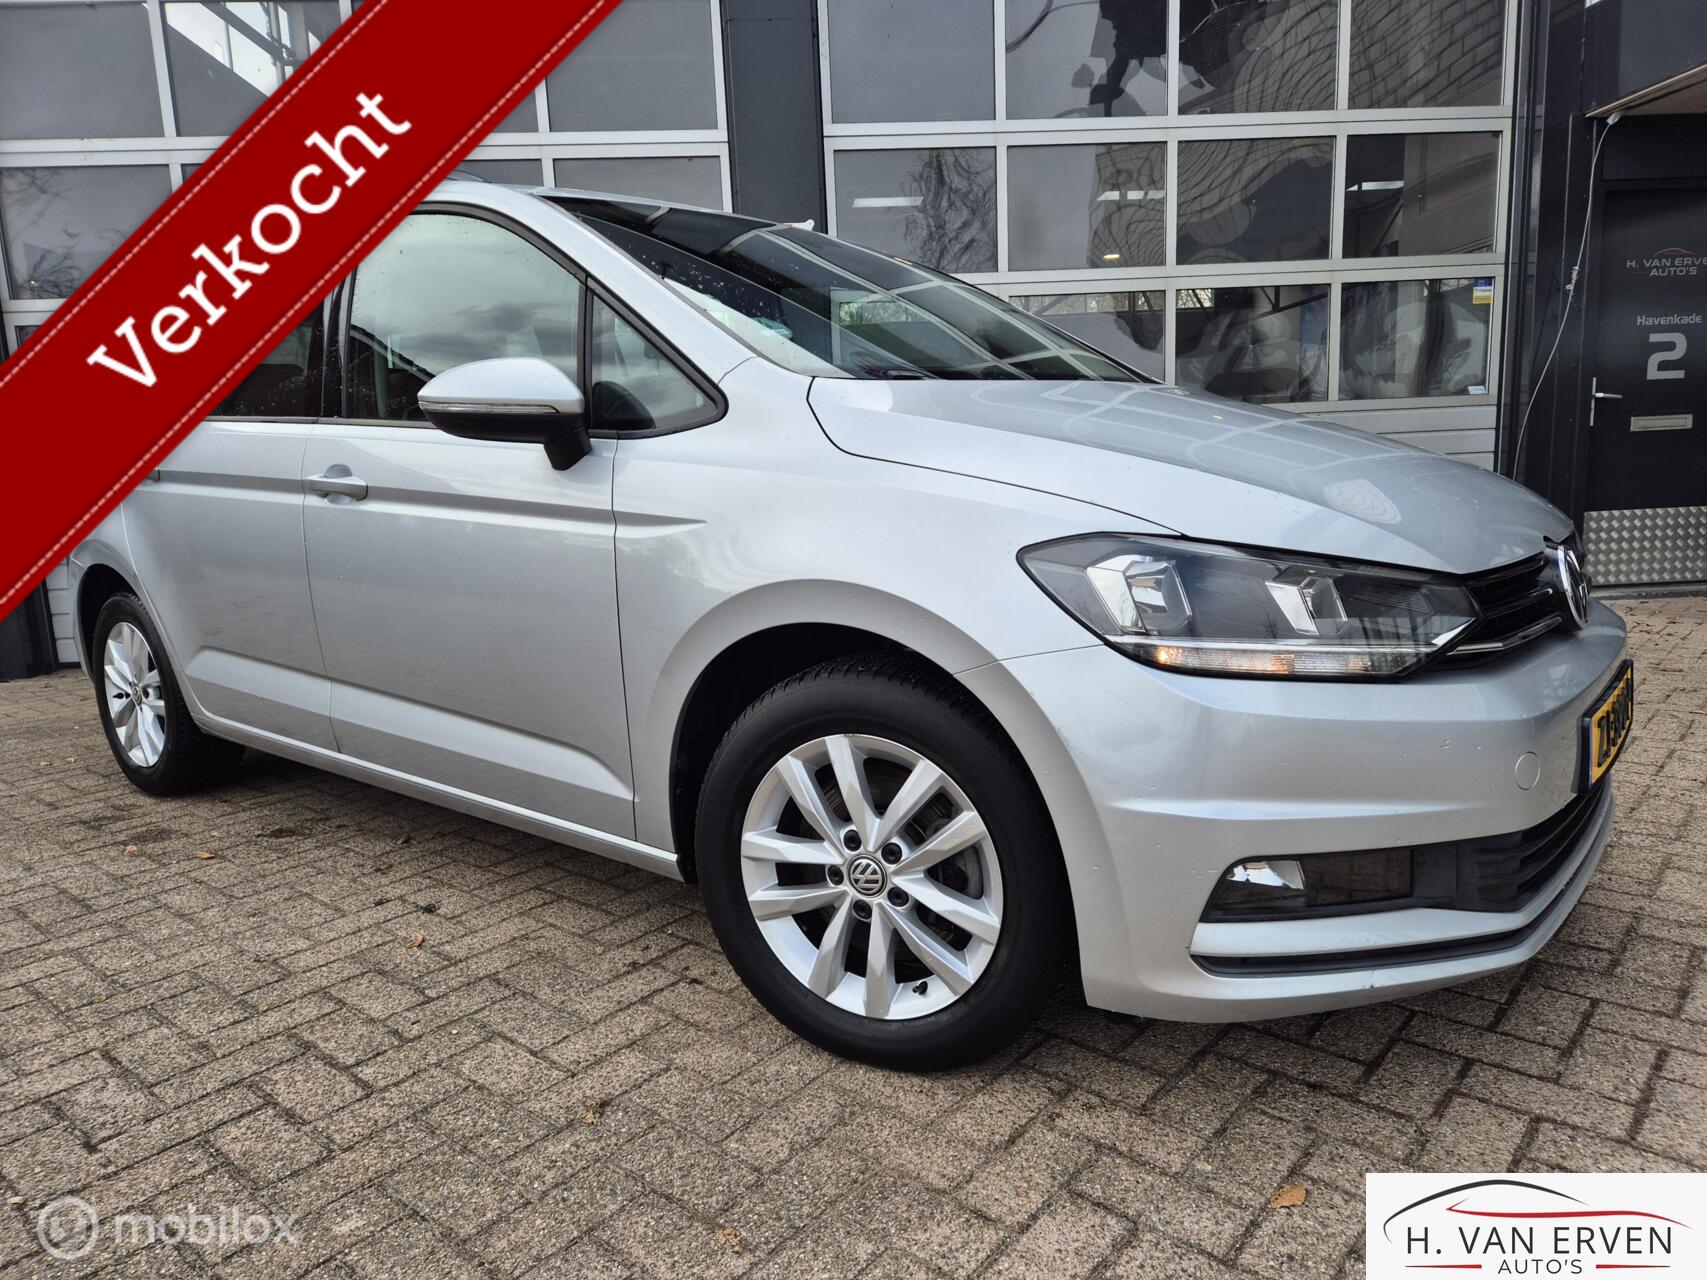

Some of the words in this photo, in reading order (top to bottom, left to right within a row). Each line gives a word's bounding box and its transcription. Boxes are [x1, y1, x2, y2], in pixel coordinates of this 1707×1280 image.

[1626, 259, 1640, 268] H.
[1643, 258, 1672, 268] VAN
[1649, 266, 1697, 277] AUTO'S
[1636, 313, 1703, 326] Havenkade
[1646, 332, 1688, 380] 2
